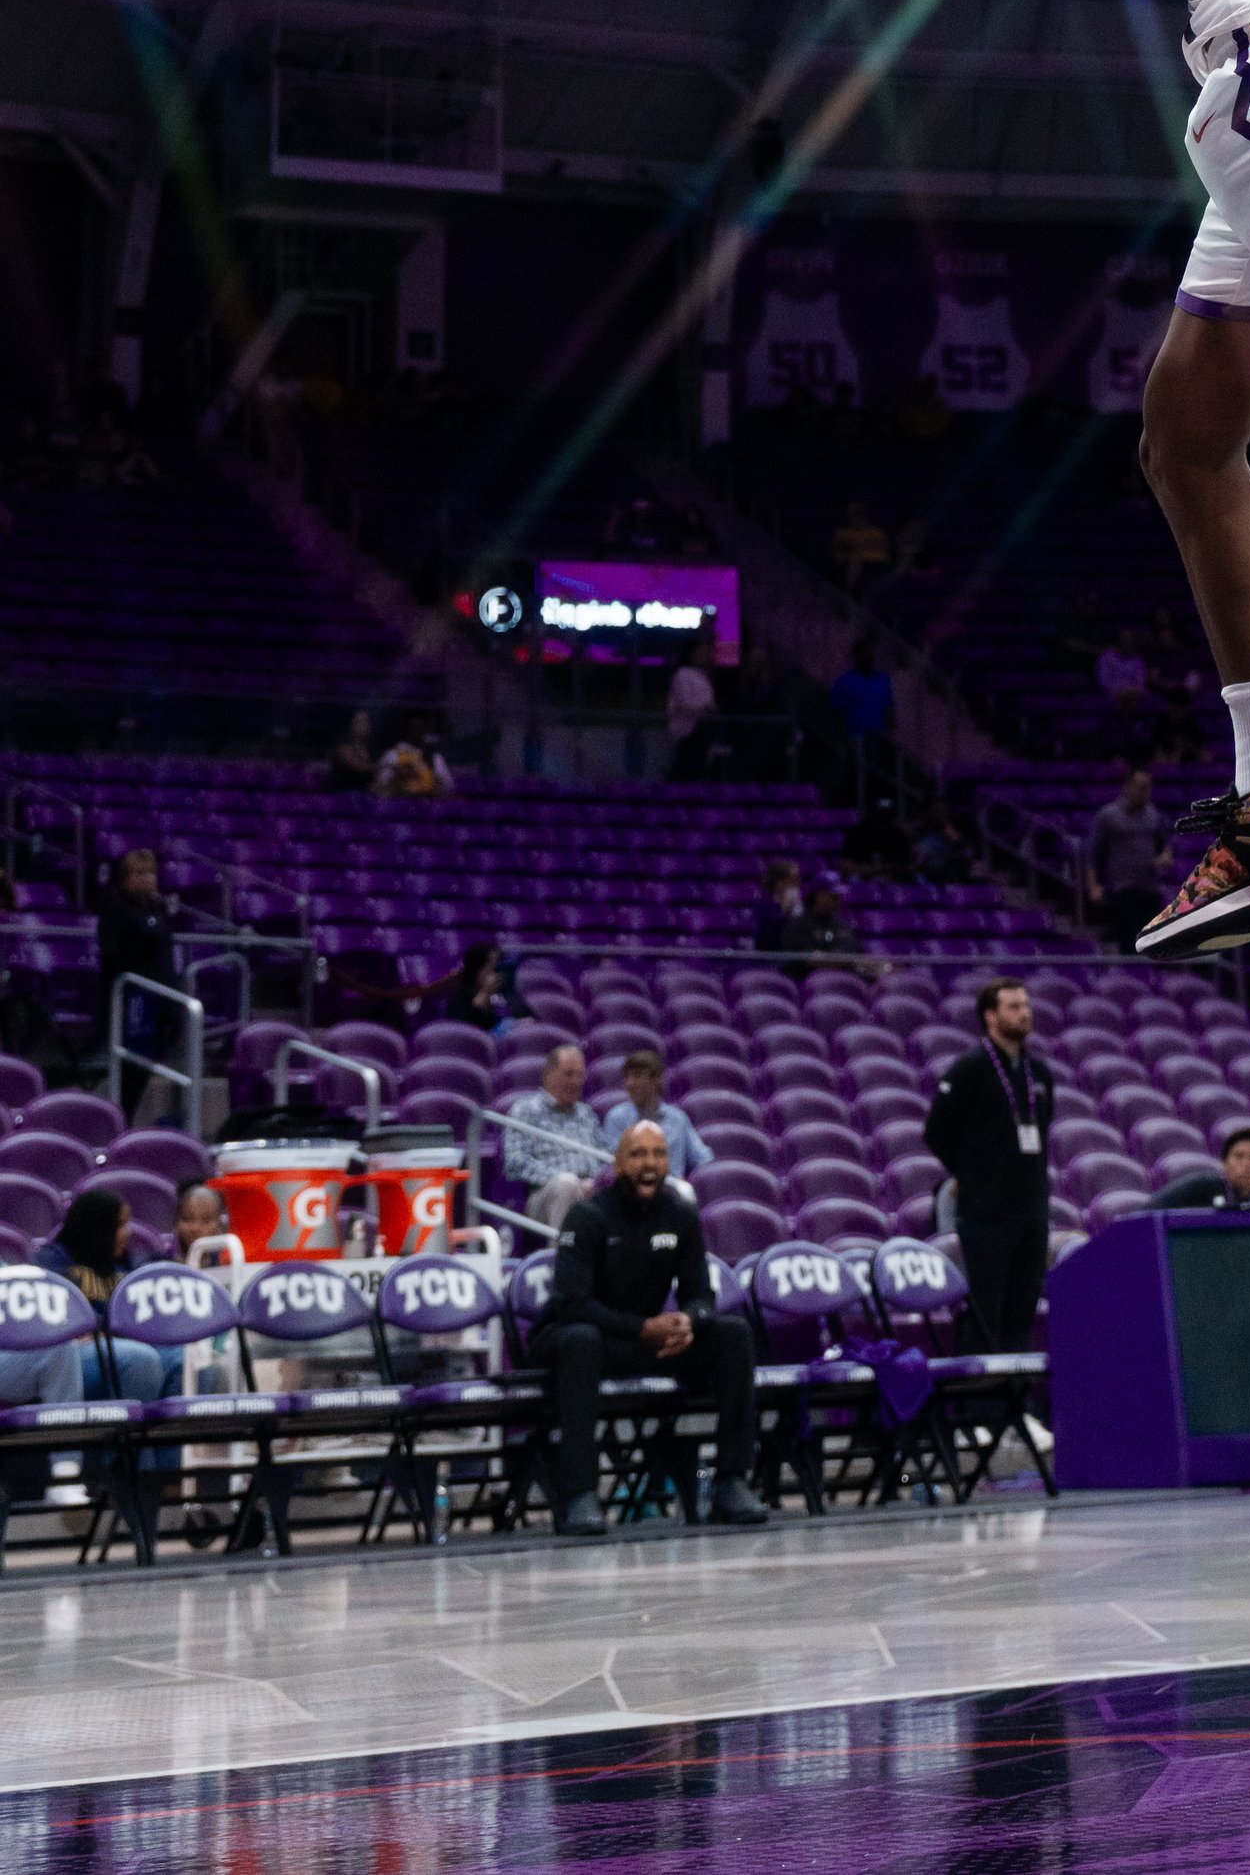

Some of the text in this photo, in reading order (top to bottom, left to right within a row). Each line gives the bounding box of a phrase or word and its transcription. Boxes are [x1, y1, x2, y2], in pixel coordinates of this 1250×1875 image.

[768, 340, 837, 389] 50
[942, 344, 1008, 392] 52
[1109, 346, 1142, 392] 5
[294, 1187, 327, 1227] G
[413, 1187, 446, 1227] G
[259, 1272, 345, 1318] TCU
[396, 1268, 477, 1315] TCU
[768, 1254, 842, 1298] TCU
[884, 1251, 946, 1293] TCU
[127, 1276, 214, 1324] TCU
